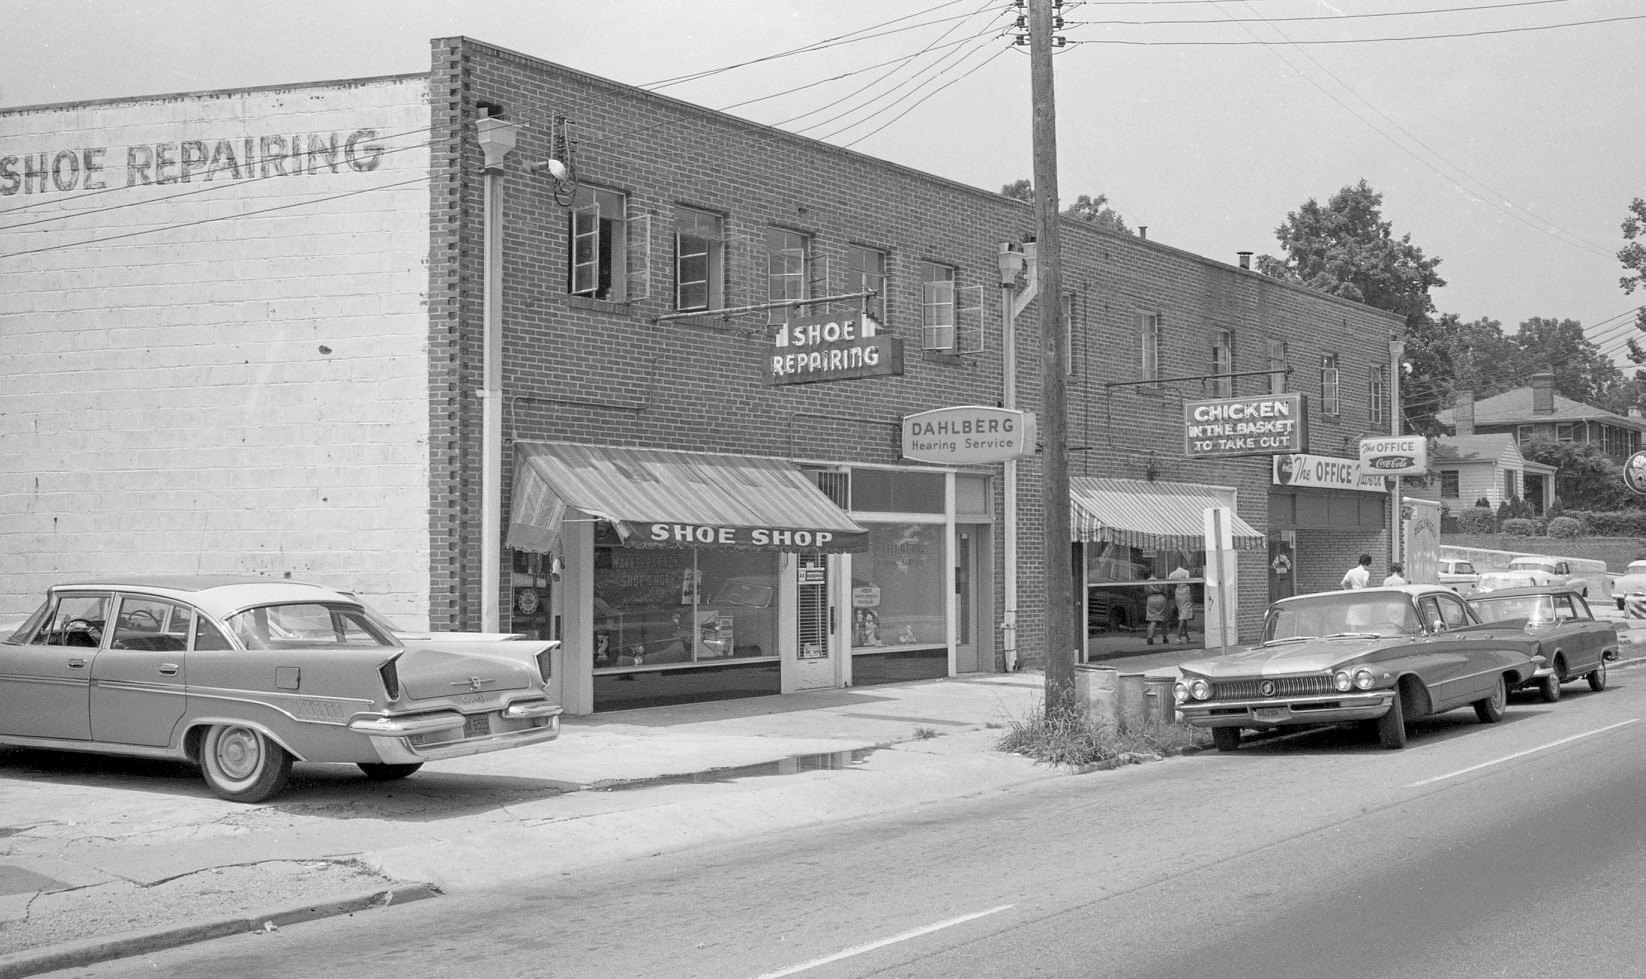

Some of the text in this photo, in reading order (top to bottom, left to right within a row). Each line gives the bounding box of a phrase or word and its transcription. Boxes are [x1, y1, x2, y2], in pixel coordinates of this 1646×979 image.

[0, 128, 386, 196] SHOE REPAIRING
[792, 320, 855, 346] SHOE
[772, 345, 879, 376] REPAIRING
[1194, 401, 1289, 422] CHICKEN
[912, 418, 1014, 436] DAHLBERG
[1189, 419, 1294, 438] IN THE BASKET
[912, 438, 1013, 452] Hearing Service
[1194, 435, 1290, 450] TO TAKE OUT
[1376, 442, 1415, 453] OFFICE
[1294, 457, 1310, 482] The
[1316, 461, 1352, 484] OFFICE
[651, 524, 833, 547] SHOE SHOP
